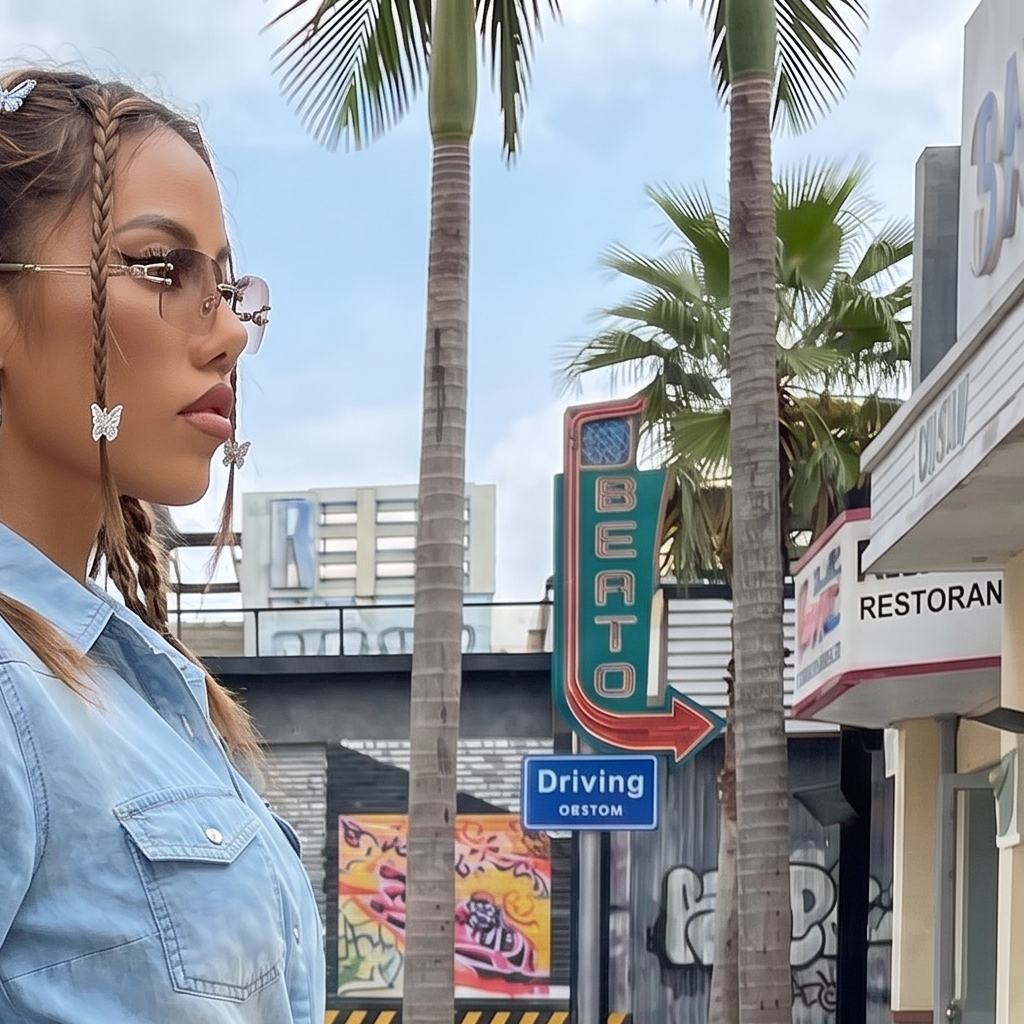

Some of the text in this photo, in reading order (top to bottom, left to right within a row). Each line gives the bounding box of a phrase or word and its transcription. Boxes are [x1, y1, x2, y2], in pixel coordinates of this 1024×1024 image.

[594, 476, 637, 699] BEATO
[859, 579, 1002, 621] RESTORAN
[537, 768, 644, 799] Driving
